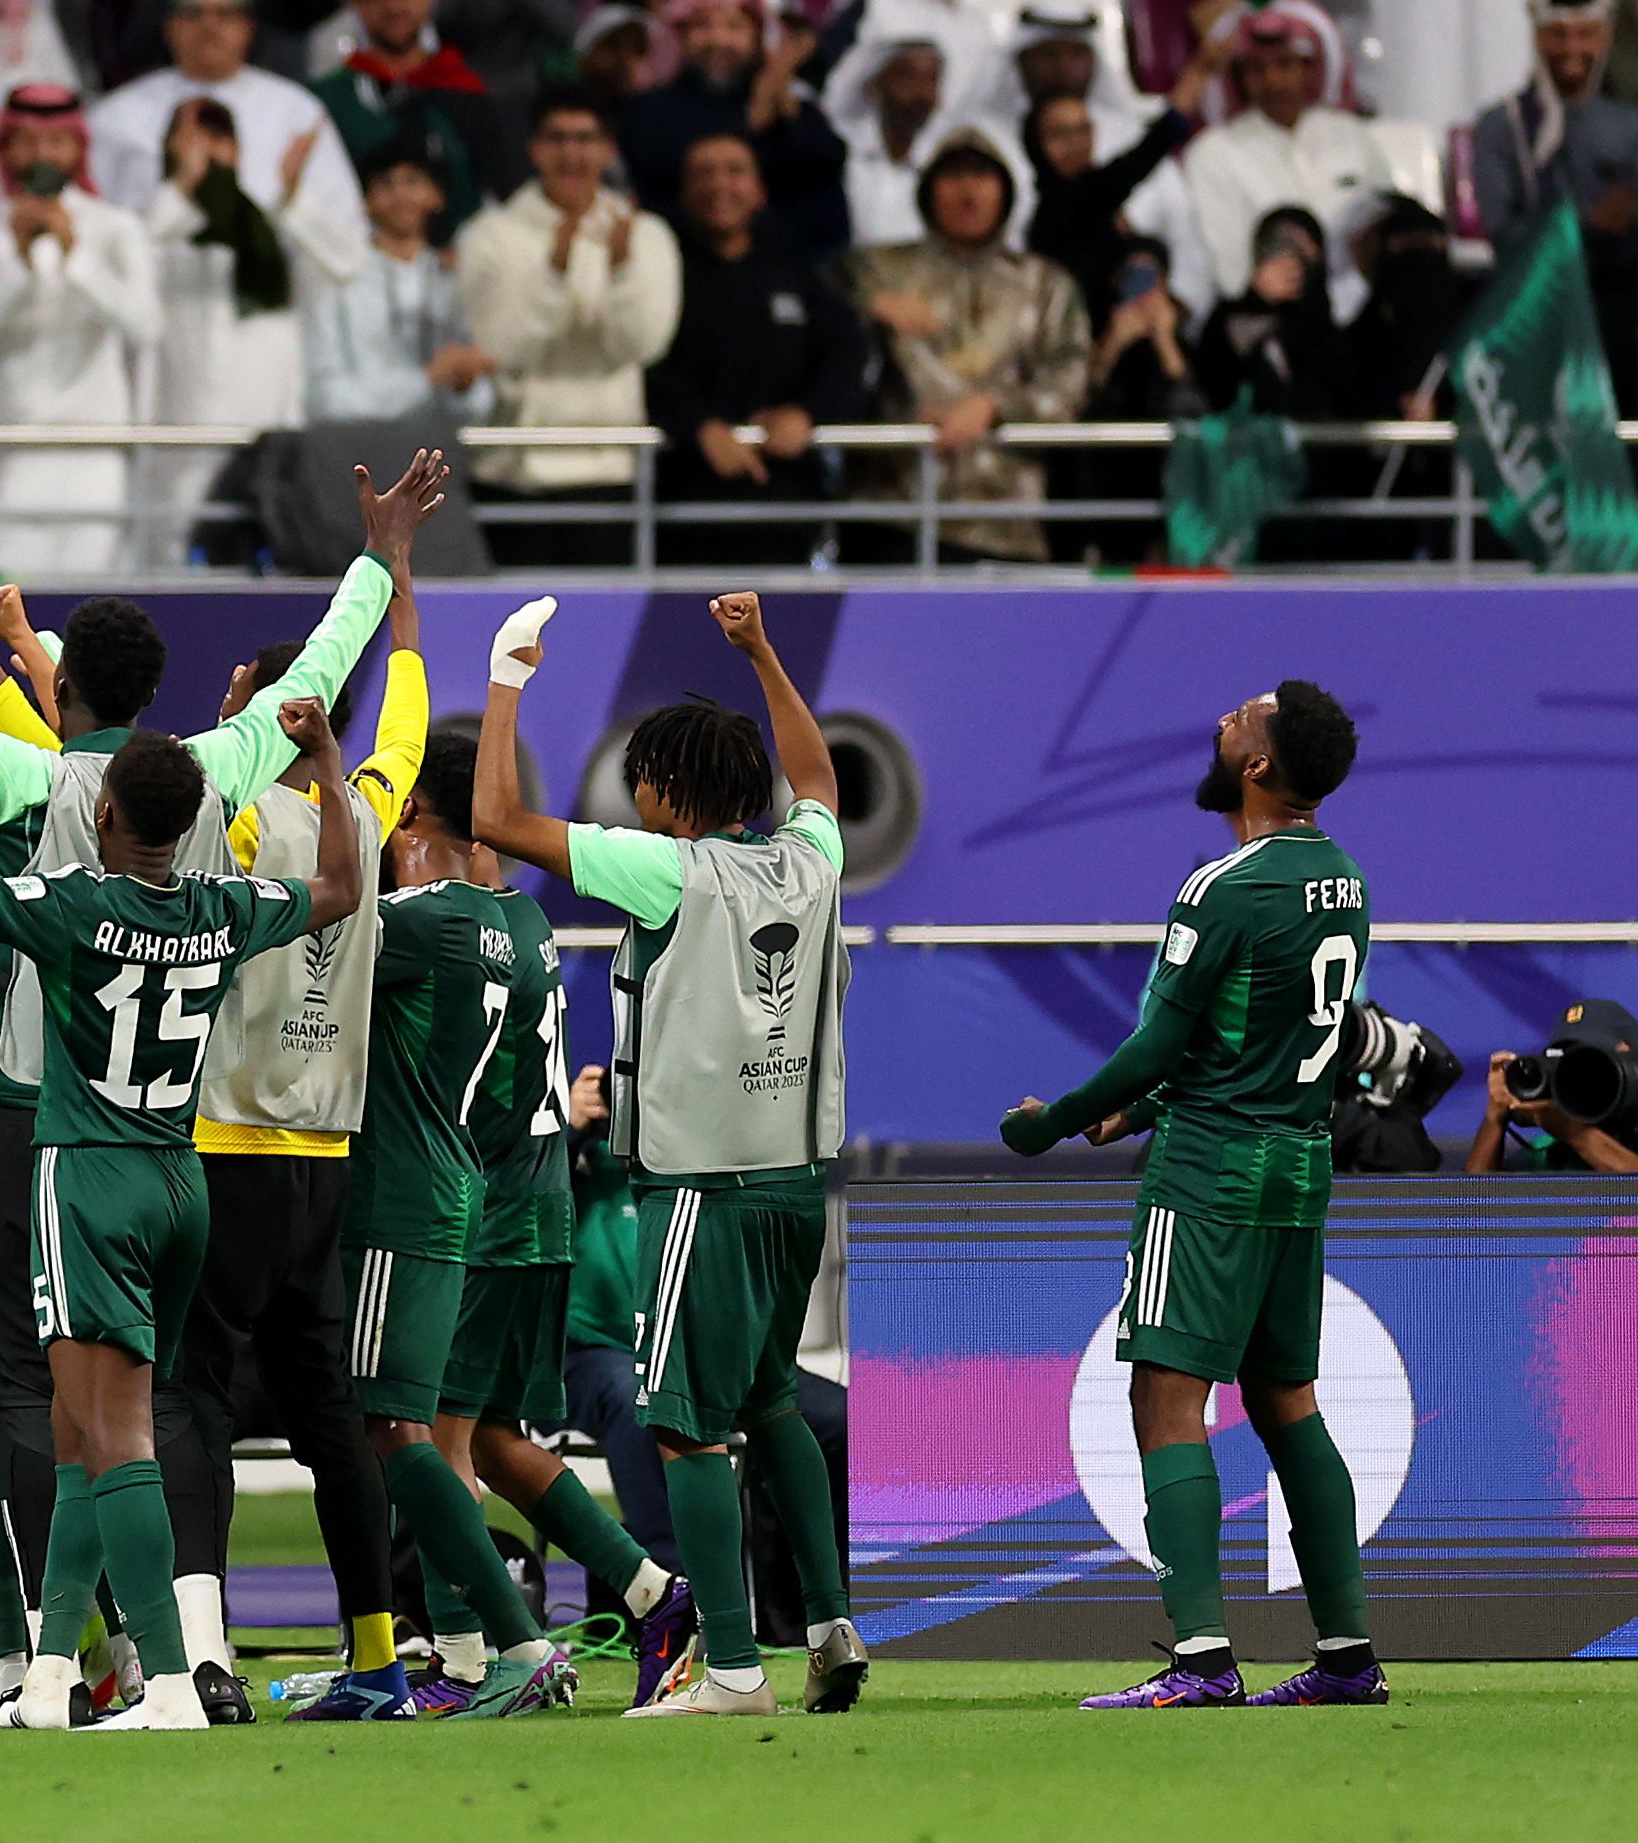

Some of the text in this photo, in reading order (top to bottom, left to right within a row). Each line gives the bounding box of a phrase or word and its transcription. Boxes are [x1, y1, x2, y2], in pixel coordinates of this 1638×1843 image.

[1304, 877, 1363, 913] FERAS
[302, 1010, 324, 1023] AFC
[1297, 935, 1358, 1083] 9
[89, 963, 221, 1110] 15
[281, 1019, 319, 1039] ASIAN
[459, 981, 509, 1126] 7
[738, 1056, 808, 1078] ASIAN CUP
[743, 1078, 779, 1096] QATAR
